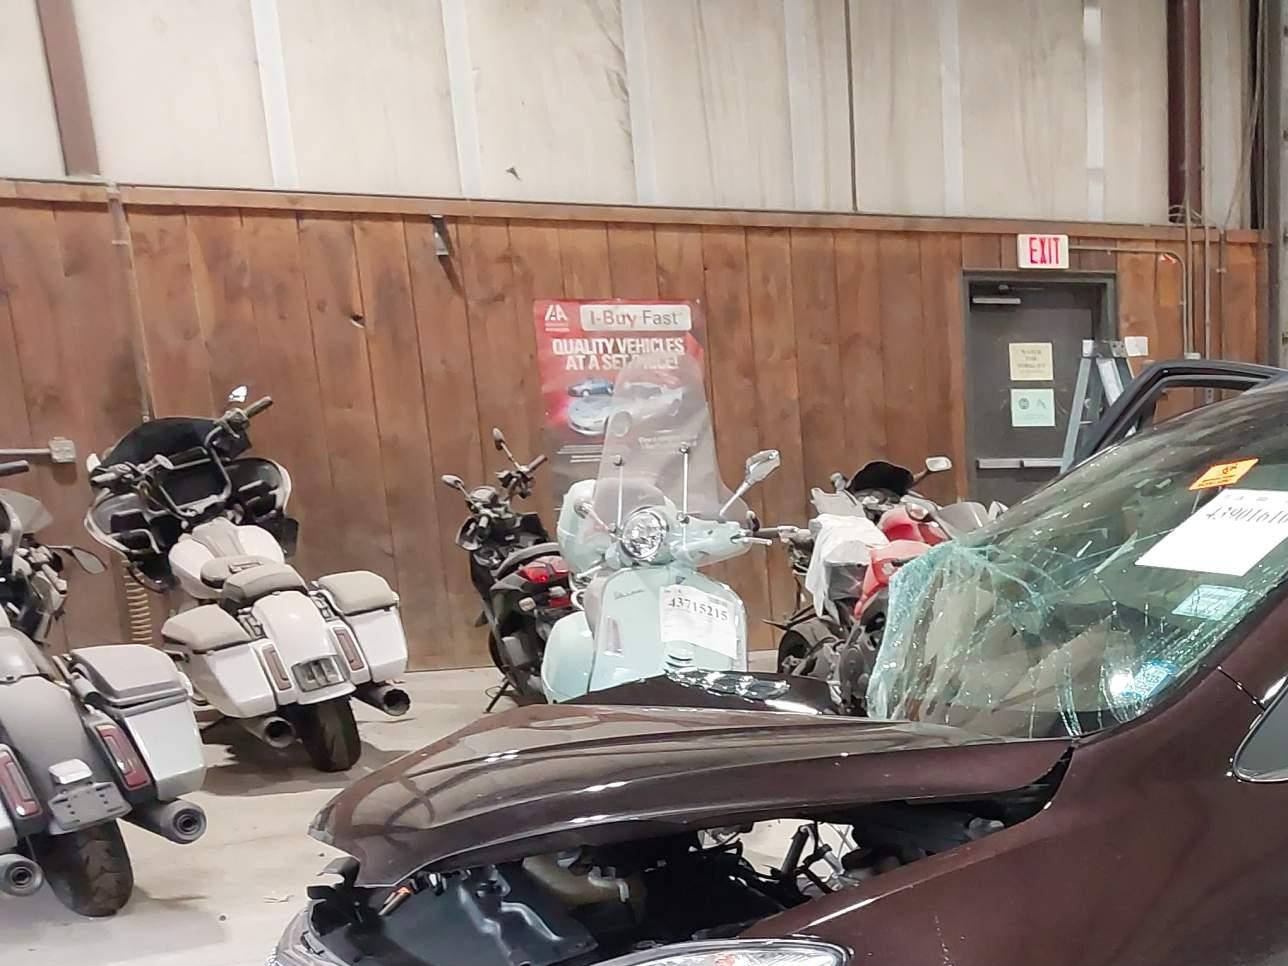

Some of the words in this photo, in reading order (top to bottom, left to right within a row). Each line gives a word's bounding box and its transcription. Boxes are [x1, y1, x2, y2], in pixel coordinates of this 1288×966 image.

[1029, 236, 1060, 264] EXIT
[590, 309, 637, 328] I-Buy
[552, 337, 615, 355] QUALITY
[615, 337, 686, 355] VEHICLES
[565, 355, 587, 371] AT
[588, 355, 601, 371] A
[601, 354, 631, 370] SET
[668, 596, 728, 621] 43715215
